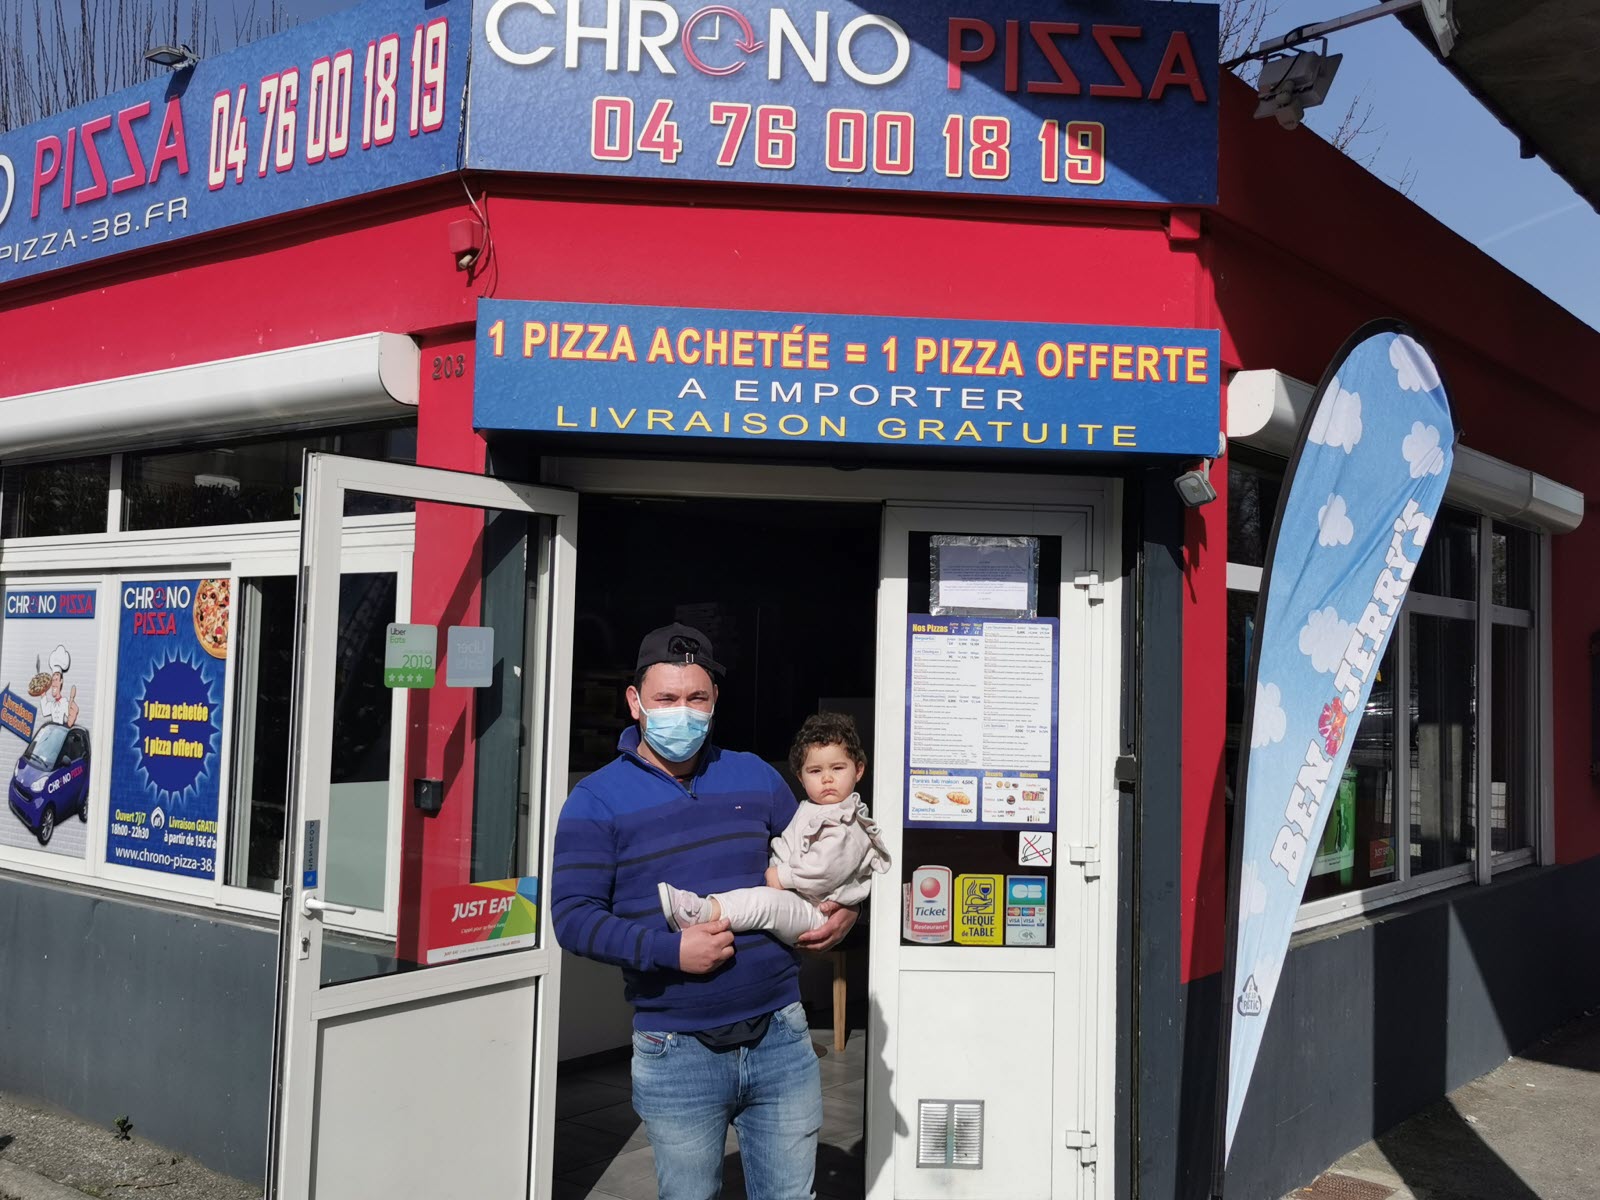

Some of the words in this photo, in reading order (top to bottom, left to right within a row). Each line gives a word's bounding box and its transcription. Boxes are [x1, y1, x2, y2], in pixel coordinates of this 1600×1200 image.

[208, 84, 248, 191] 04
[258, 66, 299, 178] 76
[306, 48, 354, 164] 00
[361, 33, 400, 149] 18
[408, 16, 449, 137] 19
[591, 96, 682, 164] 04
[710, 102, 796, 169] 76
[825, 108, 914, 175] 00
[943, 114, 1010, 179] 18
[1038, 120, 1105, 184] 19
[488, 320, 505, 357] 1
[523, 321, 637, 363] PIZZA
[647, 324, 830, 370] ACHETÉE
[882, 336, 898, 373] 1
[915, 337, 1025, 378] PIZZA
[1036, 342, 1209, 384] OFFERTE
[432, 354, 465, 380] 203
[677, 378, 707, 400] A
[735, 379, 1024, 411] EMPORTER
[556, 406, 846, 437] LIVRAISON
[877, 417, 1137, 447] GRATUITE
[390, 628, 406, 636] Uber
[912, 623, 926, 632] Nos
[927, 624, 948, 633] Pizzas
[390, 636, 405, 644] Eats
[402, 654, 433, 669] 2019
[2, 693, 34, 723] Livraison
[149, 701, 171, 721] pizza
[172, 702, 209, 722] achetée
[1, 708, 31, 738] Gratuite
[150, 737, 172, 757] pizza
[173, 738, 204, 759] offerte
[115, 809, 135, 822] Ouvert
[168, 816, 196, 831] Livraison
[1270, 739, 1334, 887] BEN
[111, 823, 129, 837] 18h00
[131, 826, 150, 840] 22h30
[168, 832, 187, 846] partir
[451, 900, 488, 923] JUST
[488, 895, 516, 915] EAT
[914, 906, 946, 917] Ticket
[961, 915, 995, 927] CHEQUE
[968, 927, 994, 937] TABLE
